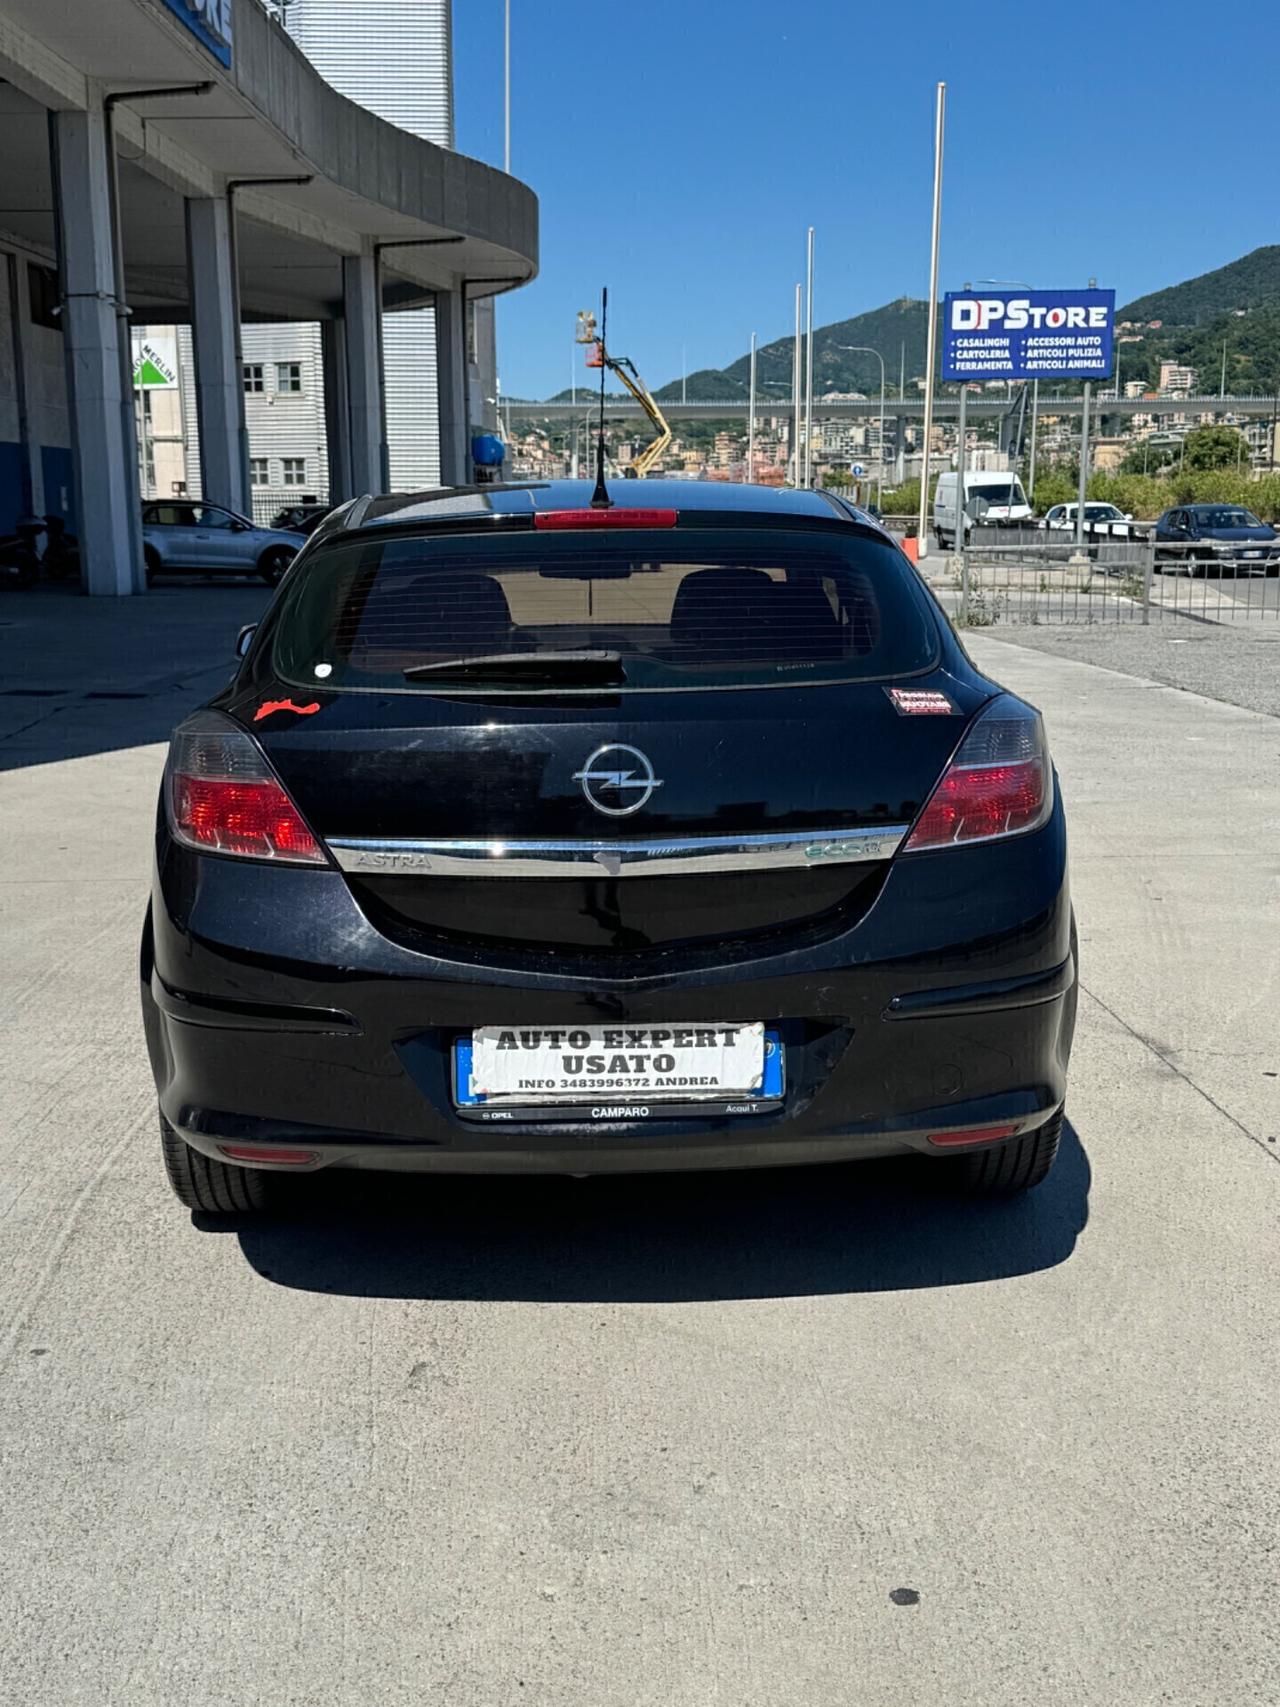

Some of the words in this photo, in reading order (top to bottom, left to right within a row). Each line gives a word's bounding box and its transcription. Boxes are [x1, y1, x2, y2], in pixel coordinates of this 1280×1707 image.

[956, 338, 1010, 347] CASALINGHI
[1027, 337, 1075, 346] ACCESSORI
[1076, 336, 1101, 346] AUTO
[956, 349, 1010, 359] CARTOLERIA
[1026, 349, 1066, 358] ARTICOLI
[1068, 348, 1102, 357] PULIZIA
[143, 344, 176, 382] MERLIN
[956, 361, 1013, 370] FERRAMENTA
[1026, 360, 1066, 369] ARTICOLI
[1067, 359, 1105, 369] ANIMALI
[357, 852, 433, 869] ASTRA
[496, 1030, 592, 1050] AUTO
[603, 1028, 741, 1049] EXPERT
[562, 1053, 676, 1075] USATO
[518, 1079, 556, 1089] INFO
[560, 1077, 650, 1089] 3483996372
[655, 1076, 719, 1087] ANDREA
[591, 1106, 650, 1119] CAMPARO
[725, 1104, 750, 1113] Acqui
